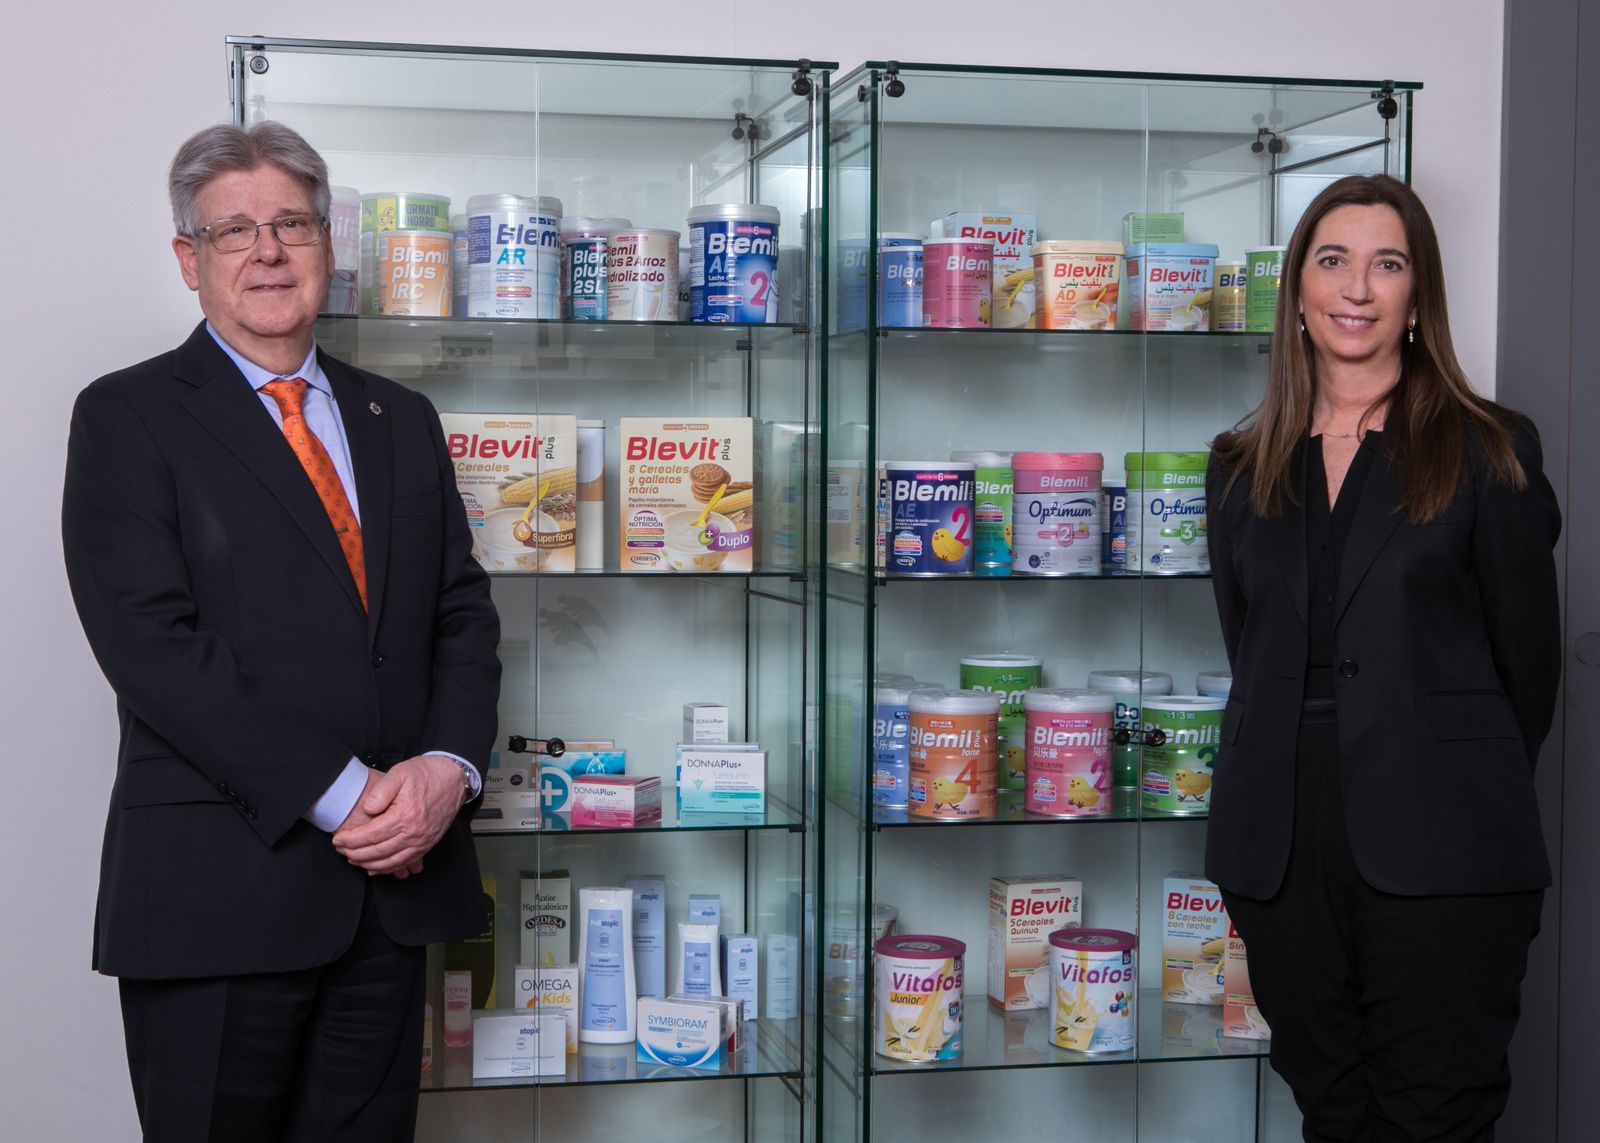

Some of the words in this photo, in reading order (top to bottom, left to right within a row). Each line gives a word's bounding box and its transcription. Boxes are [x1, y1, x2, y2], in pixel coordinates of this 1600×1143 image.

[404, 204, 439, 217] ORMATO
[404, 215, 435, 227] HORRO
[708, 233, 779, 257] Blemil
[392, 246, 449, 264] Blemil
[497, 248, 526, 265] AR
[625, 256, 634, 267] 2
[634, 256, 666, 268] Arroz
[392, 266, 436, 283] plus
[1054, 263, 1108, 278] Blevit
[1149, 268, 1202, 283] Blevit
[392, 283, 425, 299] IRC
[574, 279, 605, 294] 2SL
[750, 271, 769, 306] 2
[1055, 289, 1077, 301] AD
[447, 433, 544, 460] Blevit
[544, 436, 556, 460] plus
[626, 436, 720, 461] Blevit
[721, 438, 732, 461] plus
[457, 462, 511, 473] Cereales
[628, 464, 635, 474] 8
[640, 464, 689, 474] Cereales
[628, 476, 635, 487] y
[639, 474, 682, 487] galletas
[976, 481, 1014, 495] Blem
[1040, 477, 1084, 488] Blemil
[628, 485, 659, 495] maría
[894, 480, 969, 502] Blemil
[895, 503, 917, 518] AE
[1029, 500, 1093, 524] Optimum
[952, 506, 971, 547] 2
[1181, 524, 1193, 540] 3
[532, 532, 574, 544] Superfibra
[718, 534, 750, 549] Duplo
[1058, 527, 1071, 542] 2
[910, 726, 973, 748] Blemil
[1033, 726, 1103, 747] Blemil
[954, 759, 982, 795] 4
[1090, 758, 1108, 795] 2
[1010, 896, 1073, 917] Blevit
[1167, 892, 1226, 913] Blevi
[1010, 918, 1016, 928] 5
[1016, 917, 1055, 927] Cereales
[1168, 910, 1176, 920] 8
[1176, 912, 1218, 924] Cereales
[1186, 922, 1212, 931] leche
[1060, 962, 1133, 985] Vitafos
[520, 979, 572, 991] OMEGA
[892, 972, 963, 994] Vitafos
[542, 992, 572, 1004] Kids
[890, 993, 922, 1006] Junior
[647, 1015, 708, 1030] SYMBIORAM
